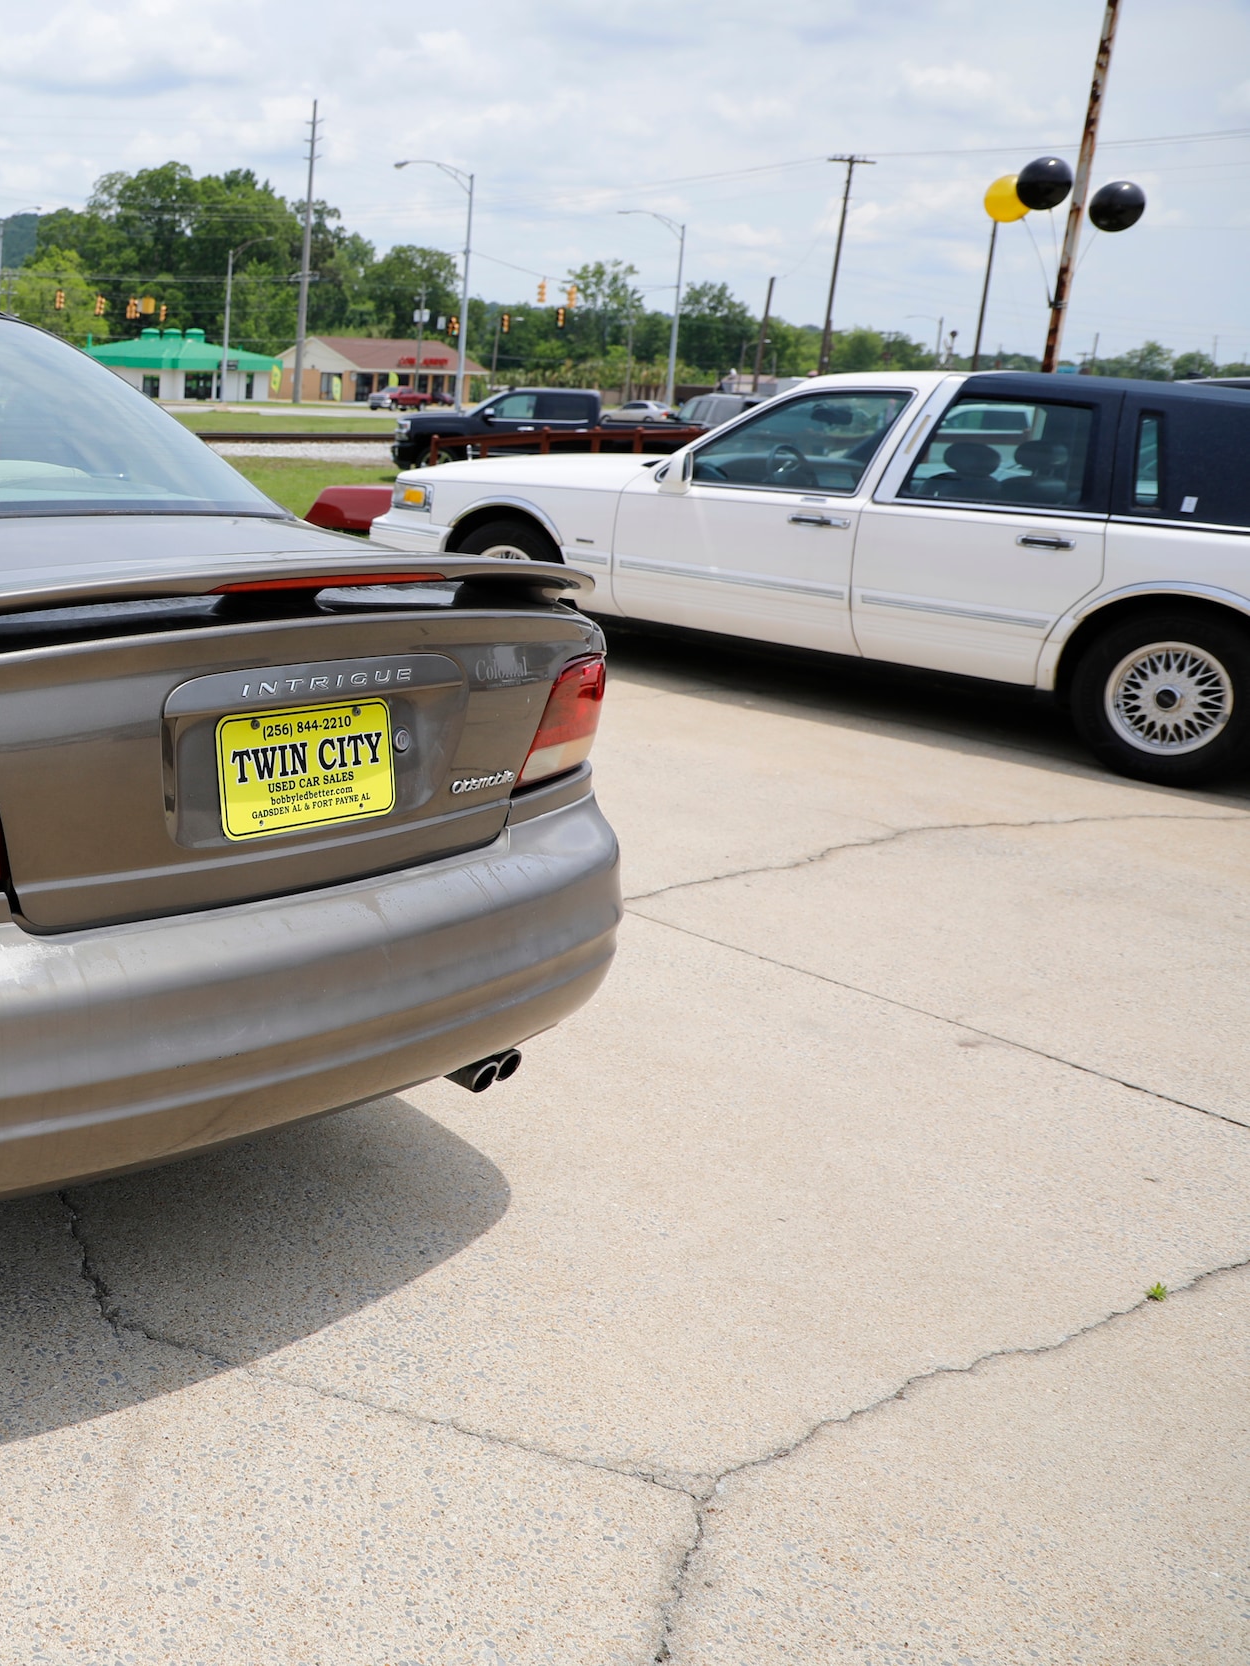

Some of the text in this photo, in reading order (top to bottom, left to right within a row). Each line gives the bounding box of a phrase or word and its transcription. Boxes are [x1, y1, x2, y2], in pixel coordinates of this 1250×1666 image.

[241, 668, 412, 698] INTRIGUE
[262, 715, 352, 741] (256) 844-2210
[231, 731, 382, 784] TWIN CITY
[267, 770, 354, 793] USED CAR SALES
[452, 770, 515, 794] Oldsmobile
[251, 792, 371, 819] GADSDEN AL & FORT PAYNE AL
[270, 786, 353, 806] bobbyledbetter.com
